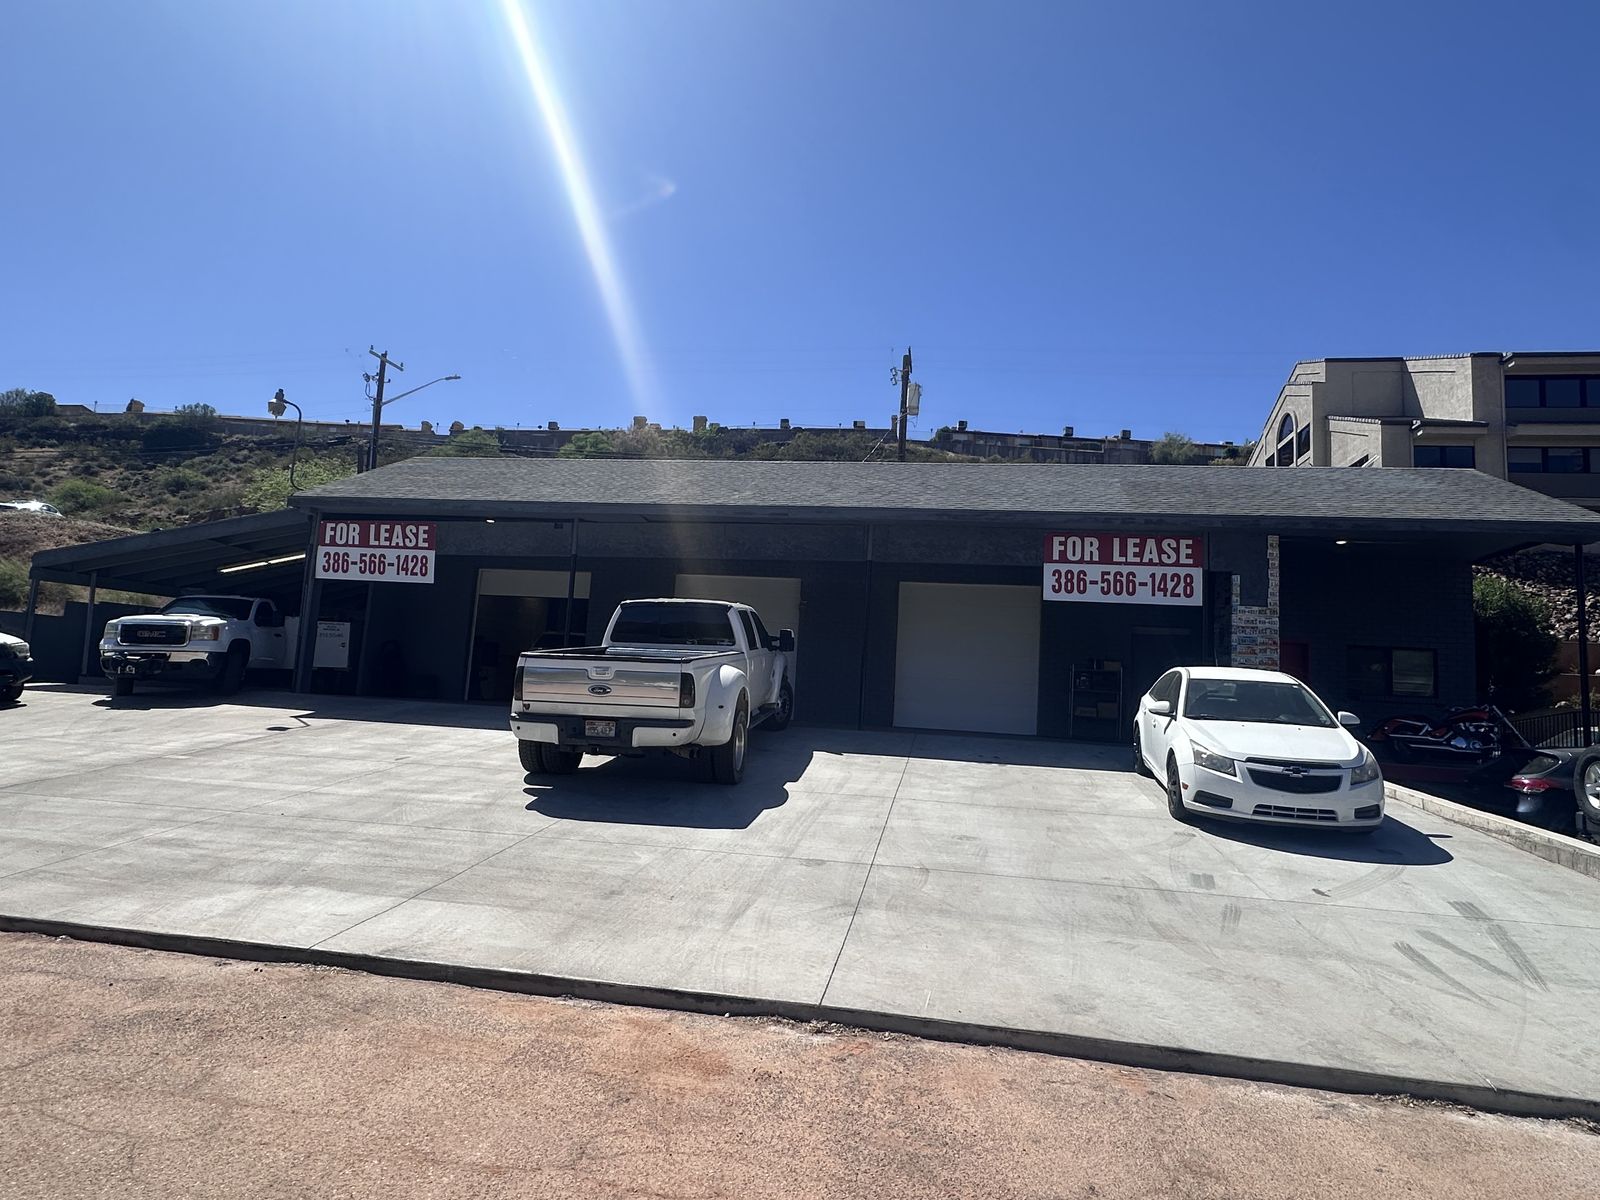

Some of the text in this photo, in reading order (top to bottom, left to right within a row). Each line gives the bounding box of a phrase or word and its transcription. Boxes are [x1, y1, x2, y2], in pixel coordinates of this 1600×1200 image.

[325, 523, 429, 547] FOR LEASE
[1052, 536, 1194, 564] FOR LEASE
[322, 551, 429, 577] 386-566-1428
[1051, 568, 1194, 599] 386-566-1428
